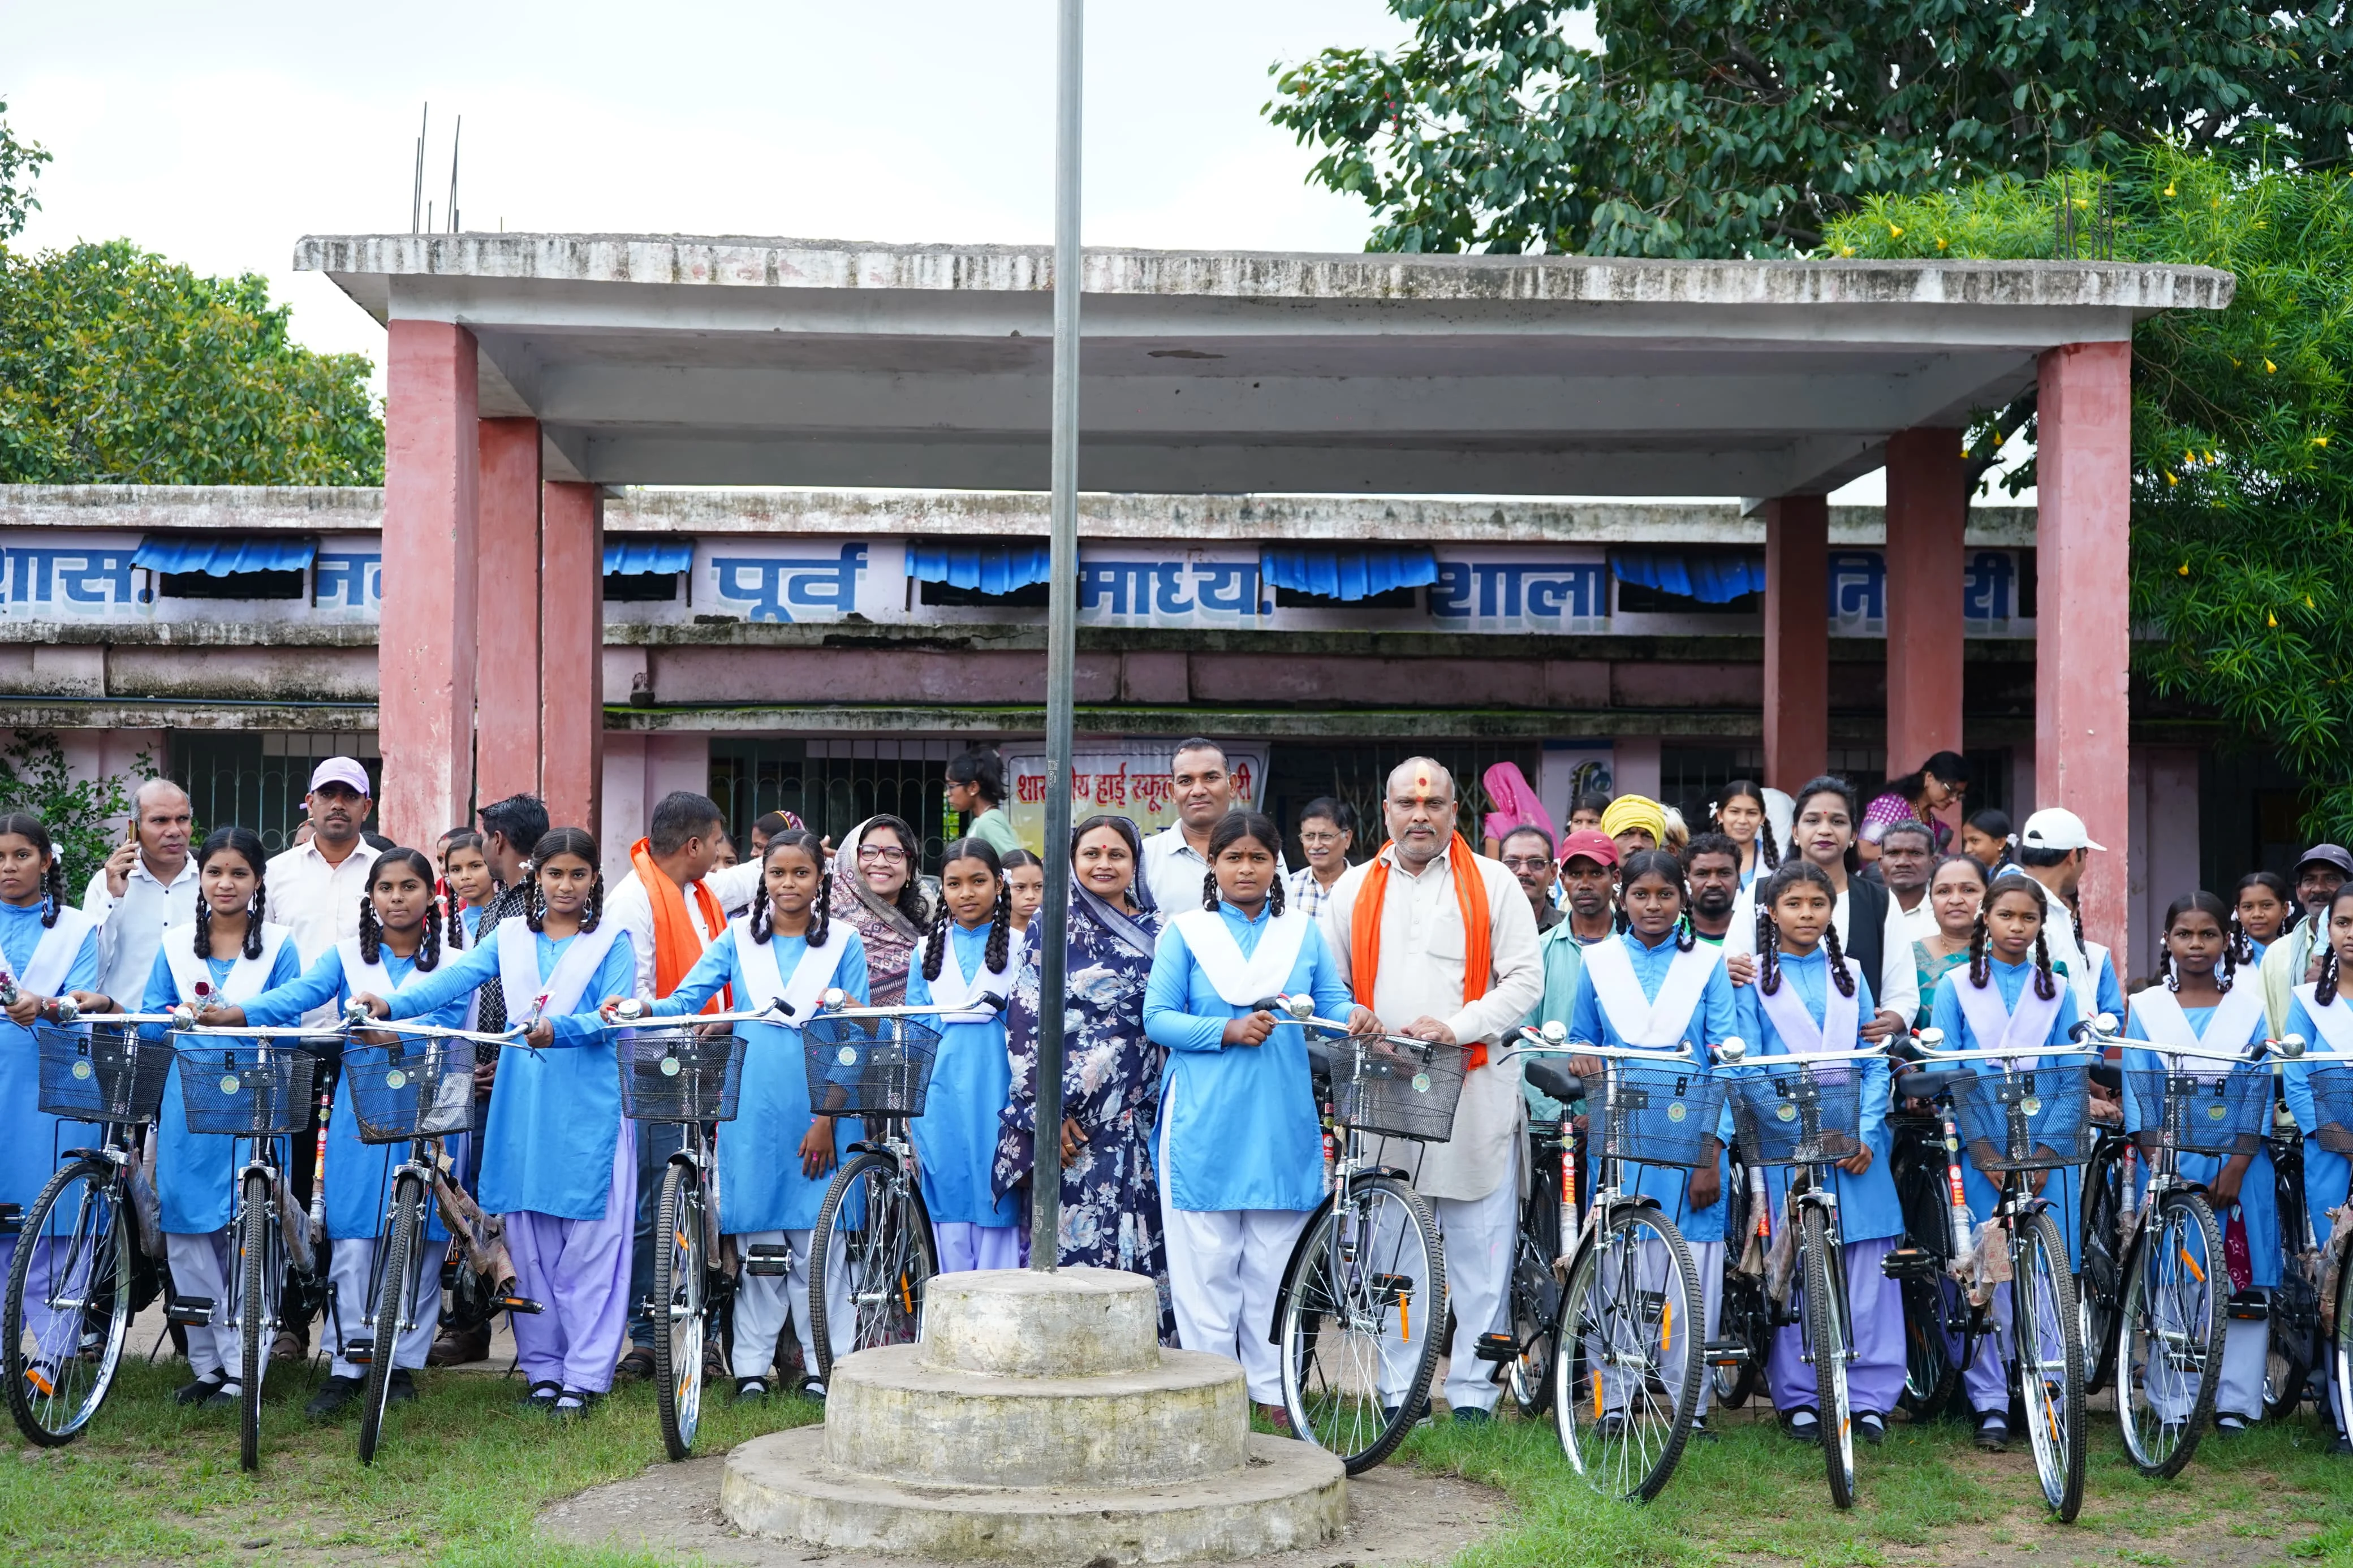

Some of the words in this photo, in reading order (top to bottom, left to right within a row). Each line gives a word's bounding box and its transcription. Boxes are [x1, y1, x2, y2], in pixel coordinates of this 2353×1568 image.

[712, 542, 868, 623] पूर्व
[1432, 561, 1606, 617] शाला
[1096, 761, 1127, 806] हाई
